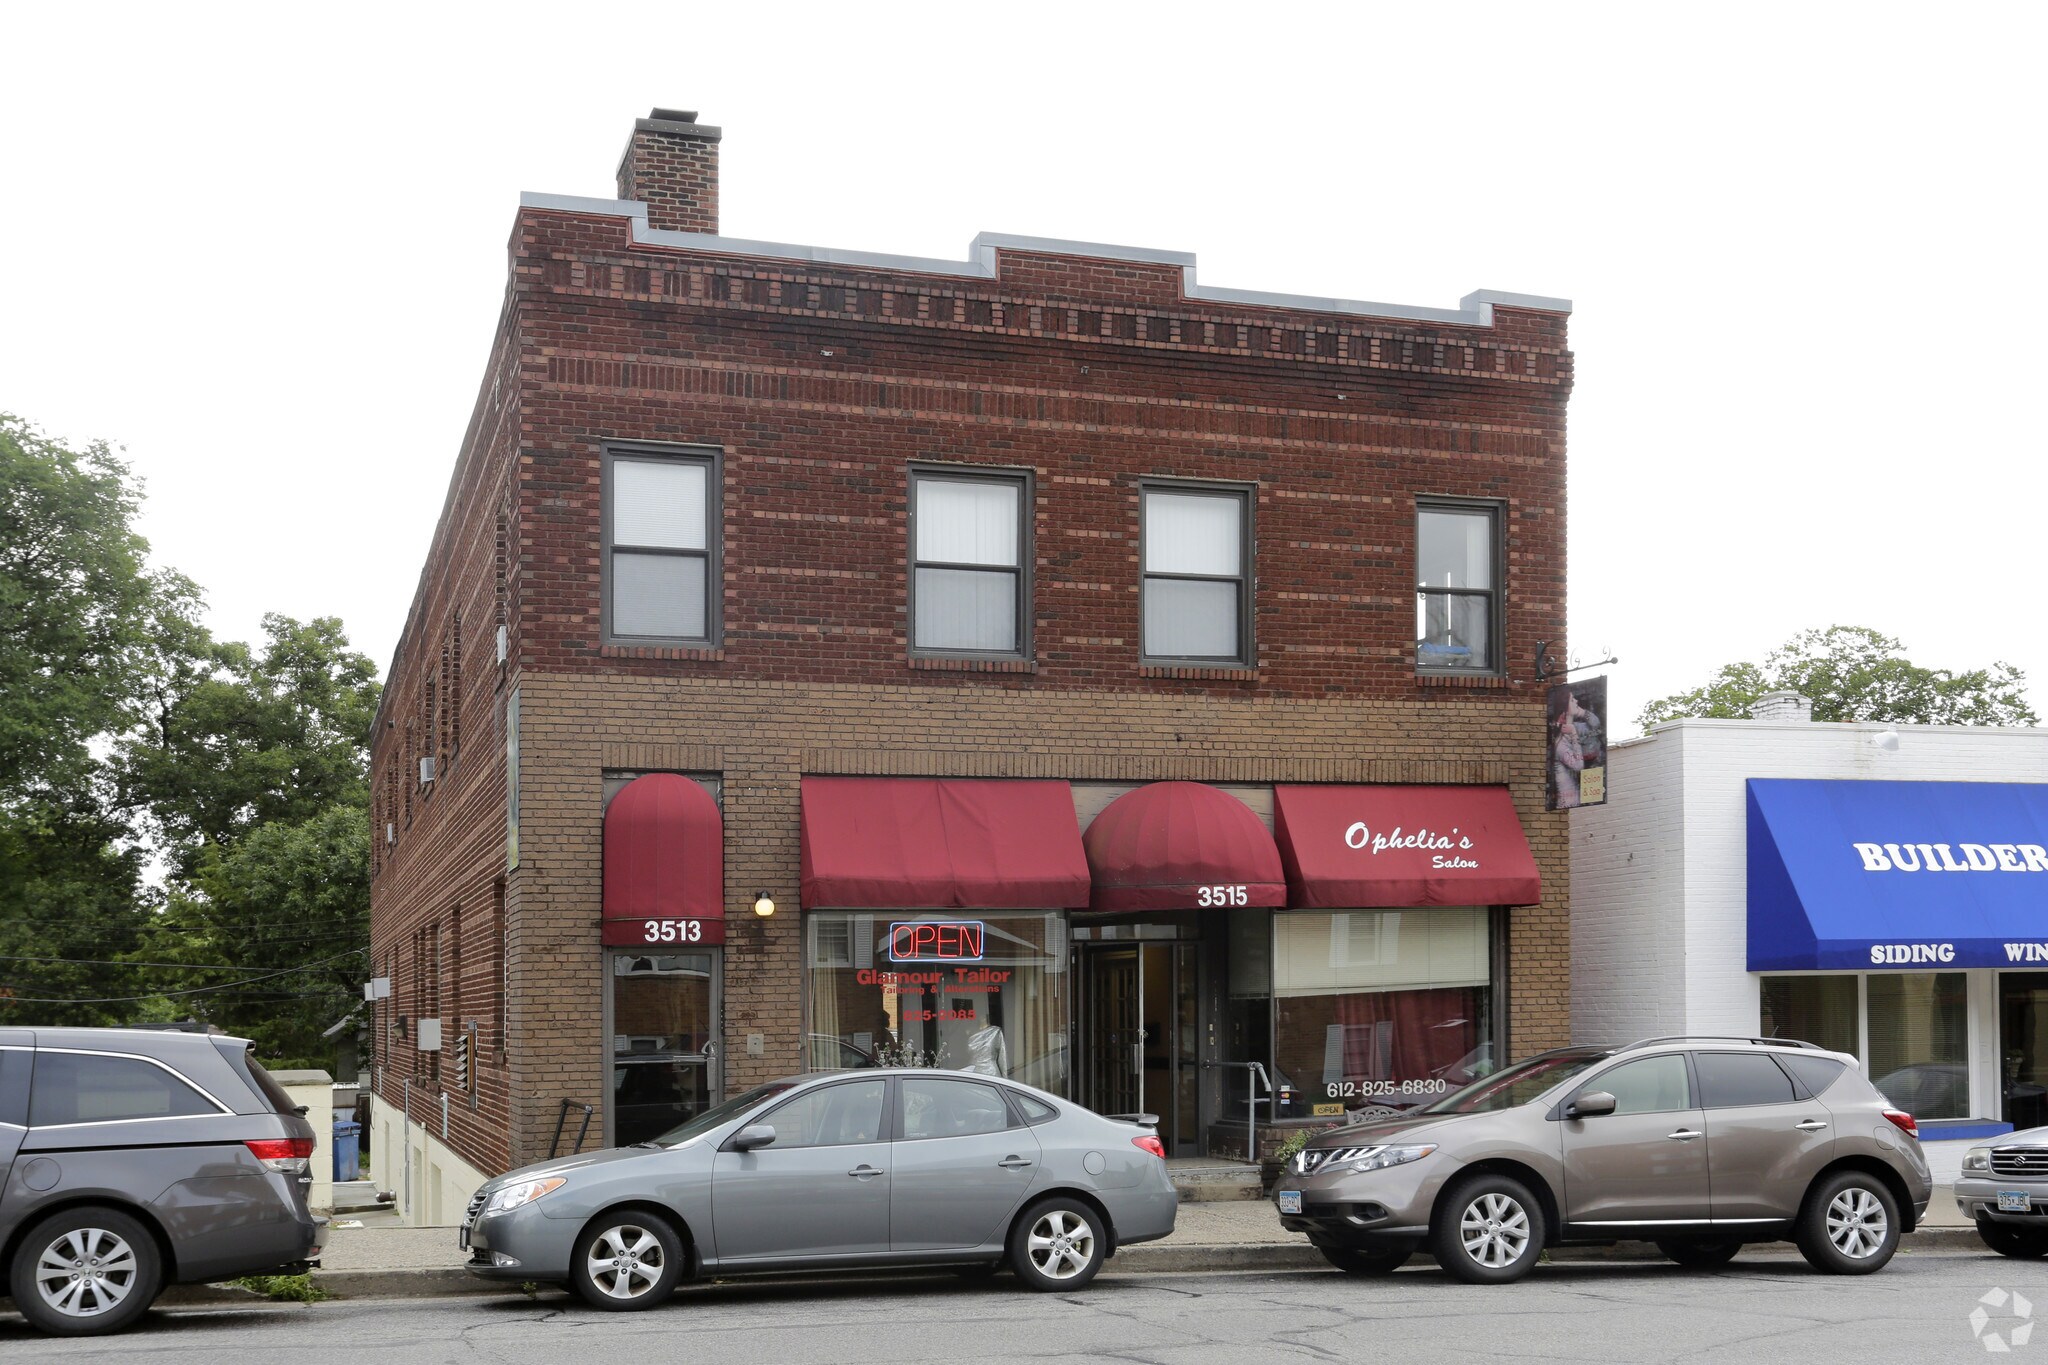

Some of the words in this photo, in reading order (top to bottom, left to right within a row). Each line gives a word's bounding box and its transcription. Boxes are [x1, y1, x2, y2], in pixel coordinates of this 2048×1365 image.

[1345, 821, 1473, 855] Ophelia's
[1432, 855, 1478, 869] Salon
[1853, 843, 2048, 872] BUILDER
[1197, 885, 1248, 907] 3515
[644, 920, 701, 942] 3513
[893, 925, 981, 958] OPEN
[1870, 943, 1955, 964] SIDING
[856, 969, 943, 985] Glamour
[954, 967, 1011, 983] Tailor
[881, 985, 925, 995] Tailoring
[930, 985, 938, 993] &
[944, 984, 1000, 993] Alterations
[1326, 1078, 1447, 1098] 612-825-6830
[1317, 1106, 1339, 1114] OPEN
